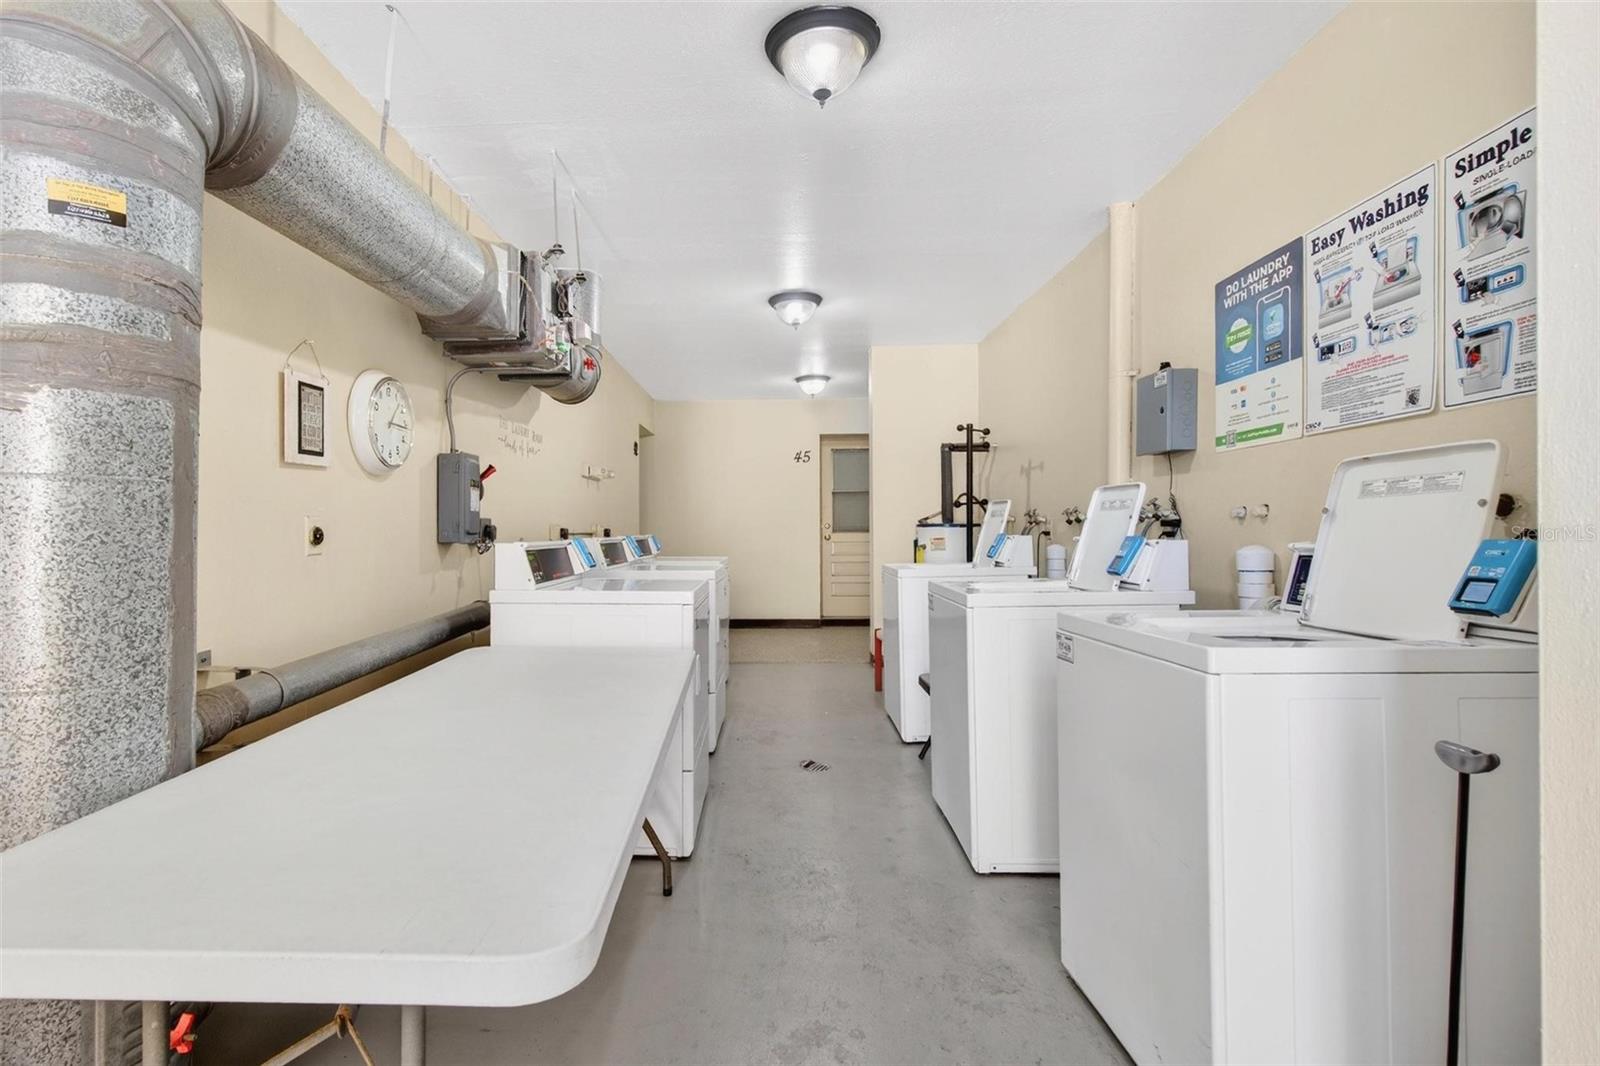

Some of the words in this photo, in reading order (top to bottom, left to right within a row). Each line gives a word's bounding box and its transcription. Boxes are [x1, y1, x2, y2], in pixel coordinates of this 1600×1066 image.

[1455, 127, 1533, 179] Simple
[1311, 227, 1346, 256] Easy
[1348, 183, 1430, 234] Washing
[1223, 288, 1248, 309] WITH
[1249, 277, 1269, 296] THE
[1271, 265, 1293, 286] APP
[1226, 281, 1239, 296] DO
[1240, 252, 1290, 288] LAUNDRY
[793, 450, 812, 464] 45
